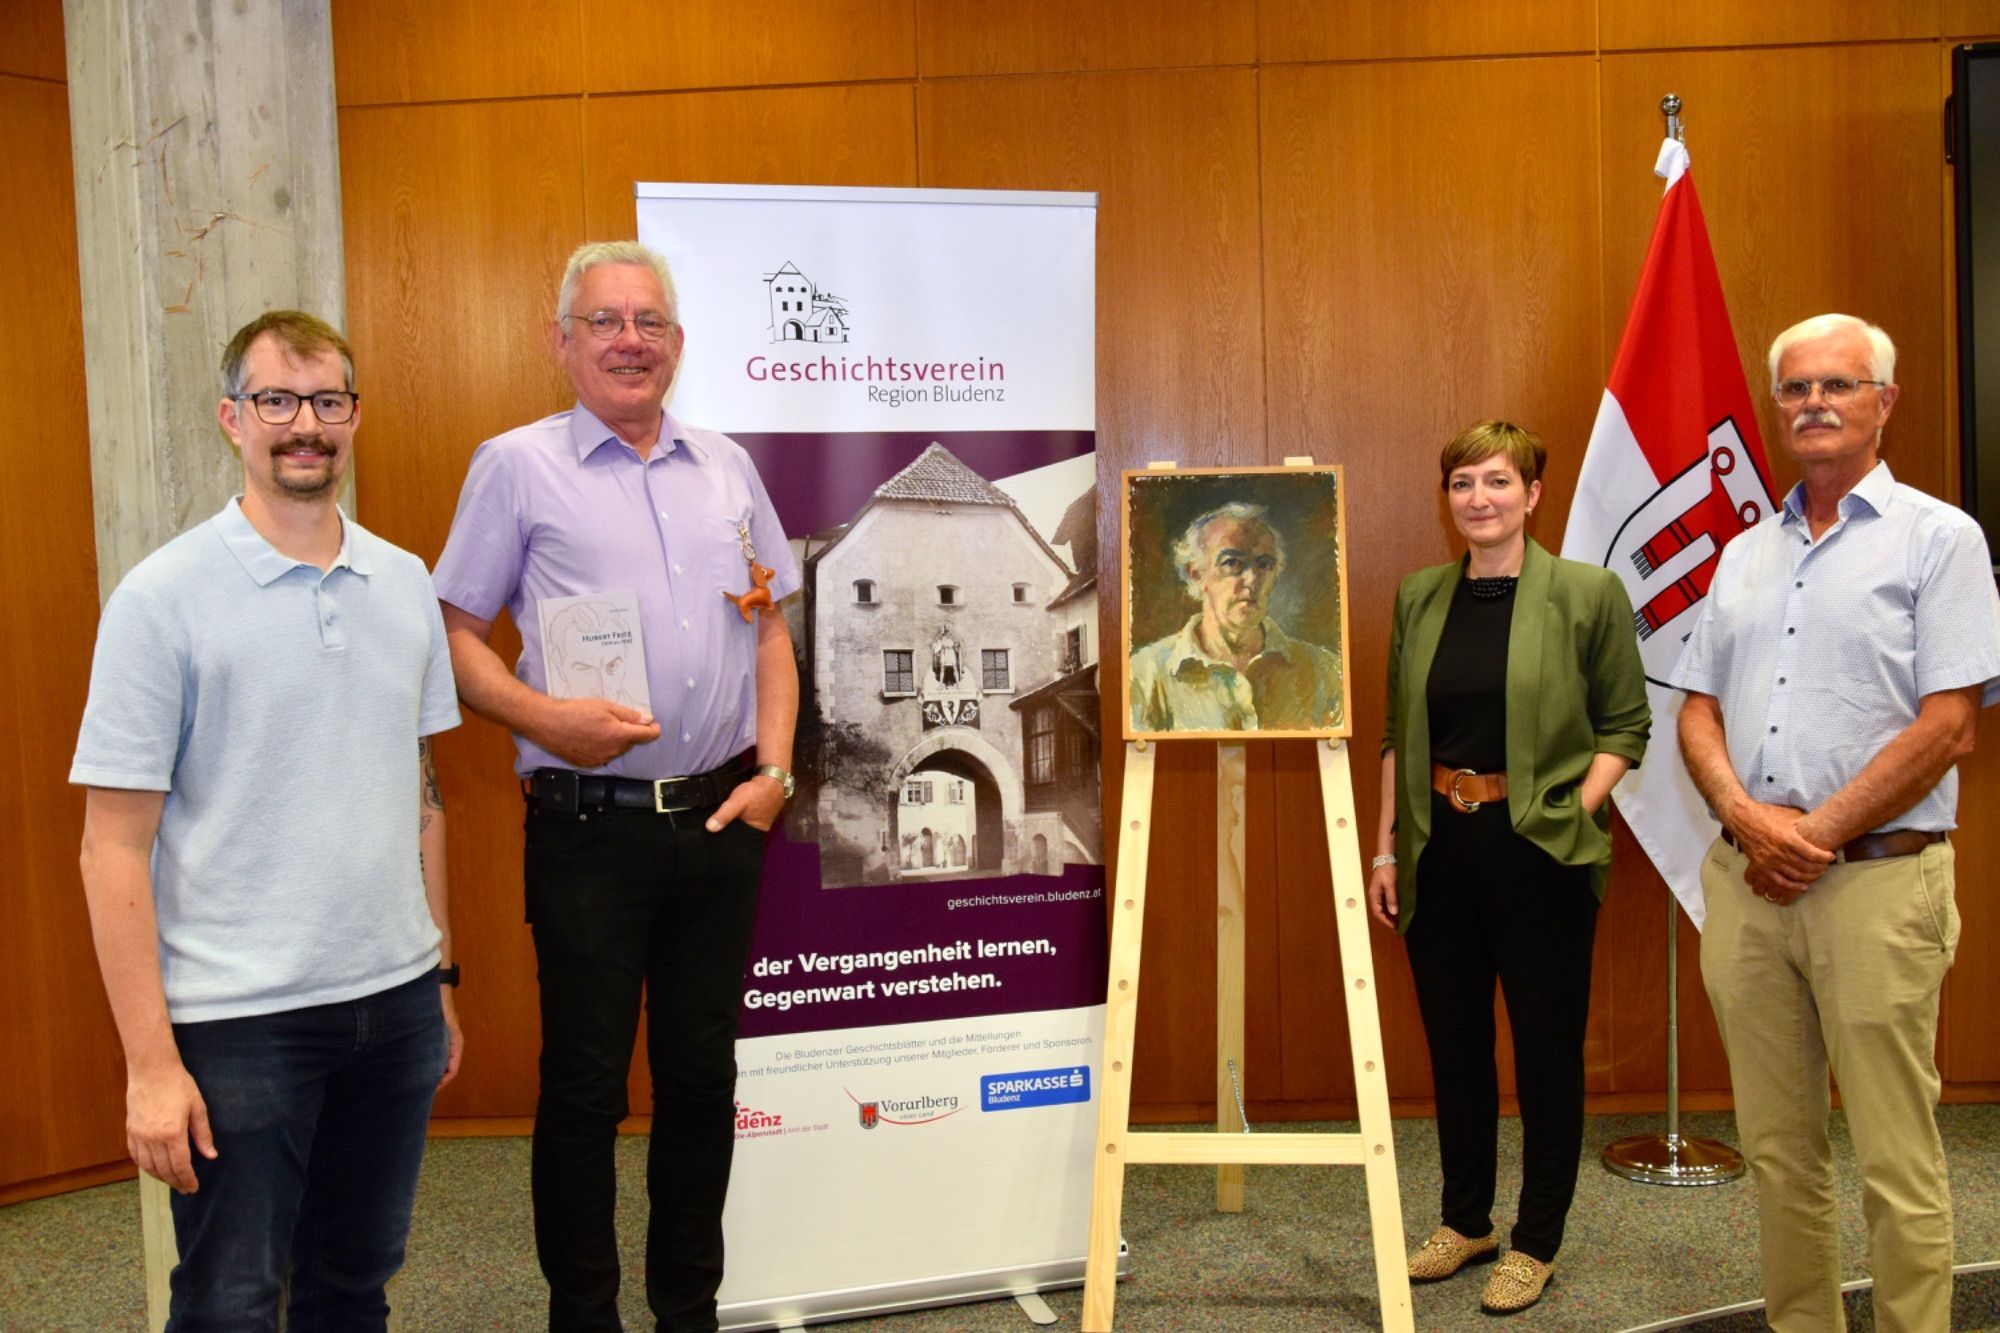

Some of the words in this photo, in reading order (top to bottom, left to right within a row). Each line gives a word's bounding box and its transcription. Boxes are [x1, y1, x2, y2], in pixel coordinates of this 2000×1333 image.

[746, 356, 1004, 381] Geschichtsverein
[868, 385, 928, 407] Region
[933, 385, 1005, 402] Bludenz
[947, 888, 1102, 910] geschichtsverein.bludenz.at
[753, 956, 793, 977] der
[798, 940, 972, 974] Vergangenheit
[977, 938, 1057, 958] lernen,
[744, 980, 875, 1011] Gegenwart
[882, 971, 1002, 998] verstehen.
[775, 1050, 792, 1061] Die
[794, 1046, 843, 1060] Bludenzer
[845, 1040, 927, 1055] Geschichtsblätter
[928, 1037, 946, 1047] und
[948, 1035, 963, 1045] die
[965, 1030, 1022, 1043] Mitteilungen
[749, 1066, 764, 1077] mit
[766, 1061, 823, 1075] freundlicher
[826, 1055, 891, 1069] Unterstützung
[894, 1053, 929, 1064] unserer
[1023, 1041, 1041, 1051] und
[987, 1075, 1069, 1096] SPARKASSE
[881, 1096, 958, 1112] Vorarlberg
[988, 1093, 1021, 1105] Bludenz
[736, 1114, 783, 1131] denz
[746, 1127, 783, 1139] Alpenstadt
